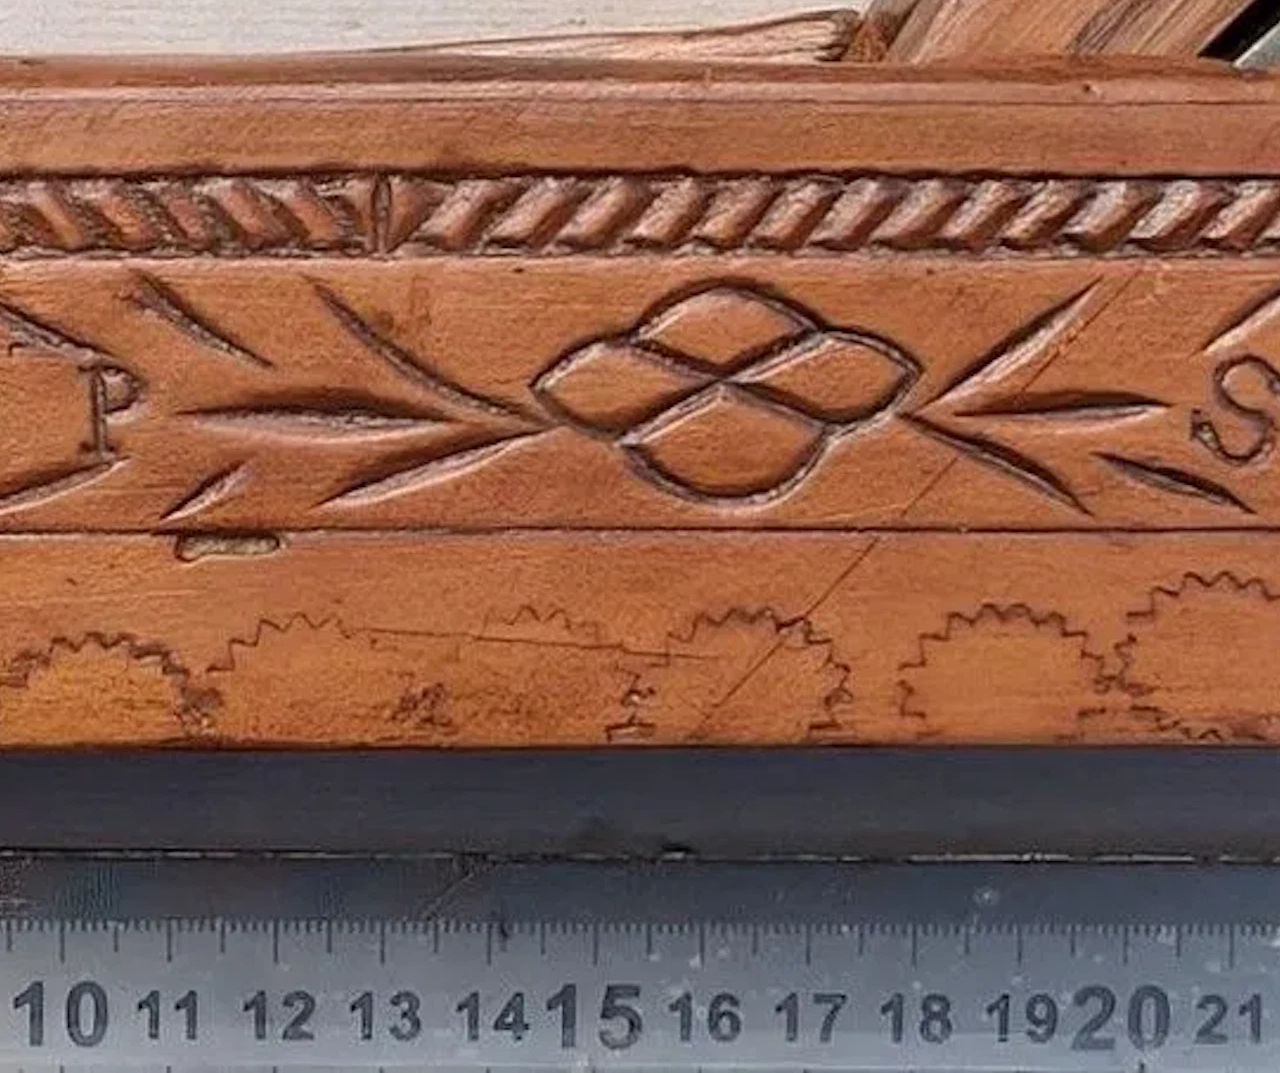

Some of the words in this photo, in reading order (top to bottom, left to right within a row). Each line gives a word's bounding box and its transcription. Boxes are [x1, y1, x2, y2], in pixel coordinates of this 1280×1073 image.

[77, 362, 149, 454] P
[13, 981, 108, 1047] 10
[137, 990, 197, 1040] 11
[243, 990, 316, 1040] 12
[350, 991, 421, 1041] 13
[456, 991, 530, 1040] 14
[546, 983, 642, 1049] 15
[669, 992, 741, 1041] 16
[775, 992, 848, 1041] 17
[880, 993, 952, 1043] 18
[986, 993, 1058, 1042] 19
[1073, 984, 1170, 1049] 20
[1196, 994, 1262, 1044] 21
